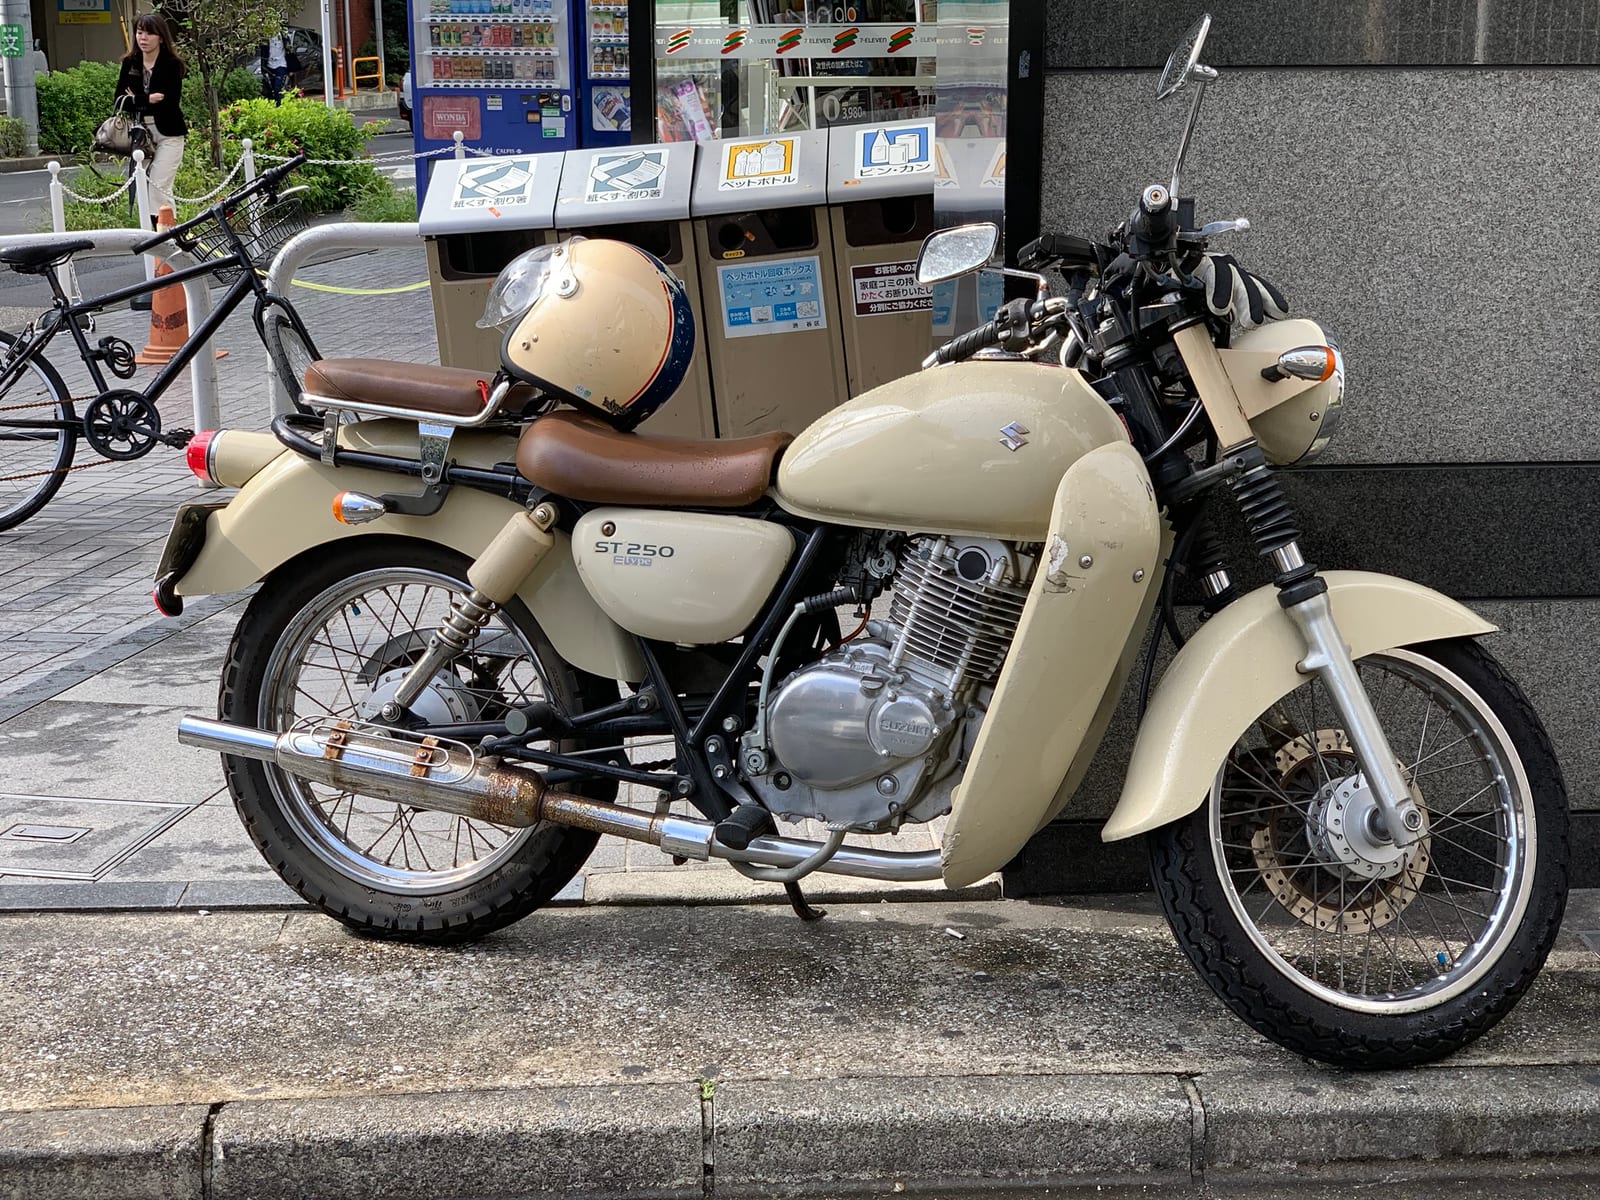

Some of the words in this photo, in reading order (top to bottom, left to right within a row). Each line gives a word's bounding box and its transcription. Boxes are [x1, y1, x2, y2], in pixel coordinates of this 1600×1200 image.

[721, 175, 797, 189] ペットボトル
[726, 264, 813, 281] ペットボトル回収ボックス
[594, 541, 623, 553] ST
[627, 543, 675, 558] 250
